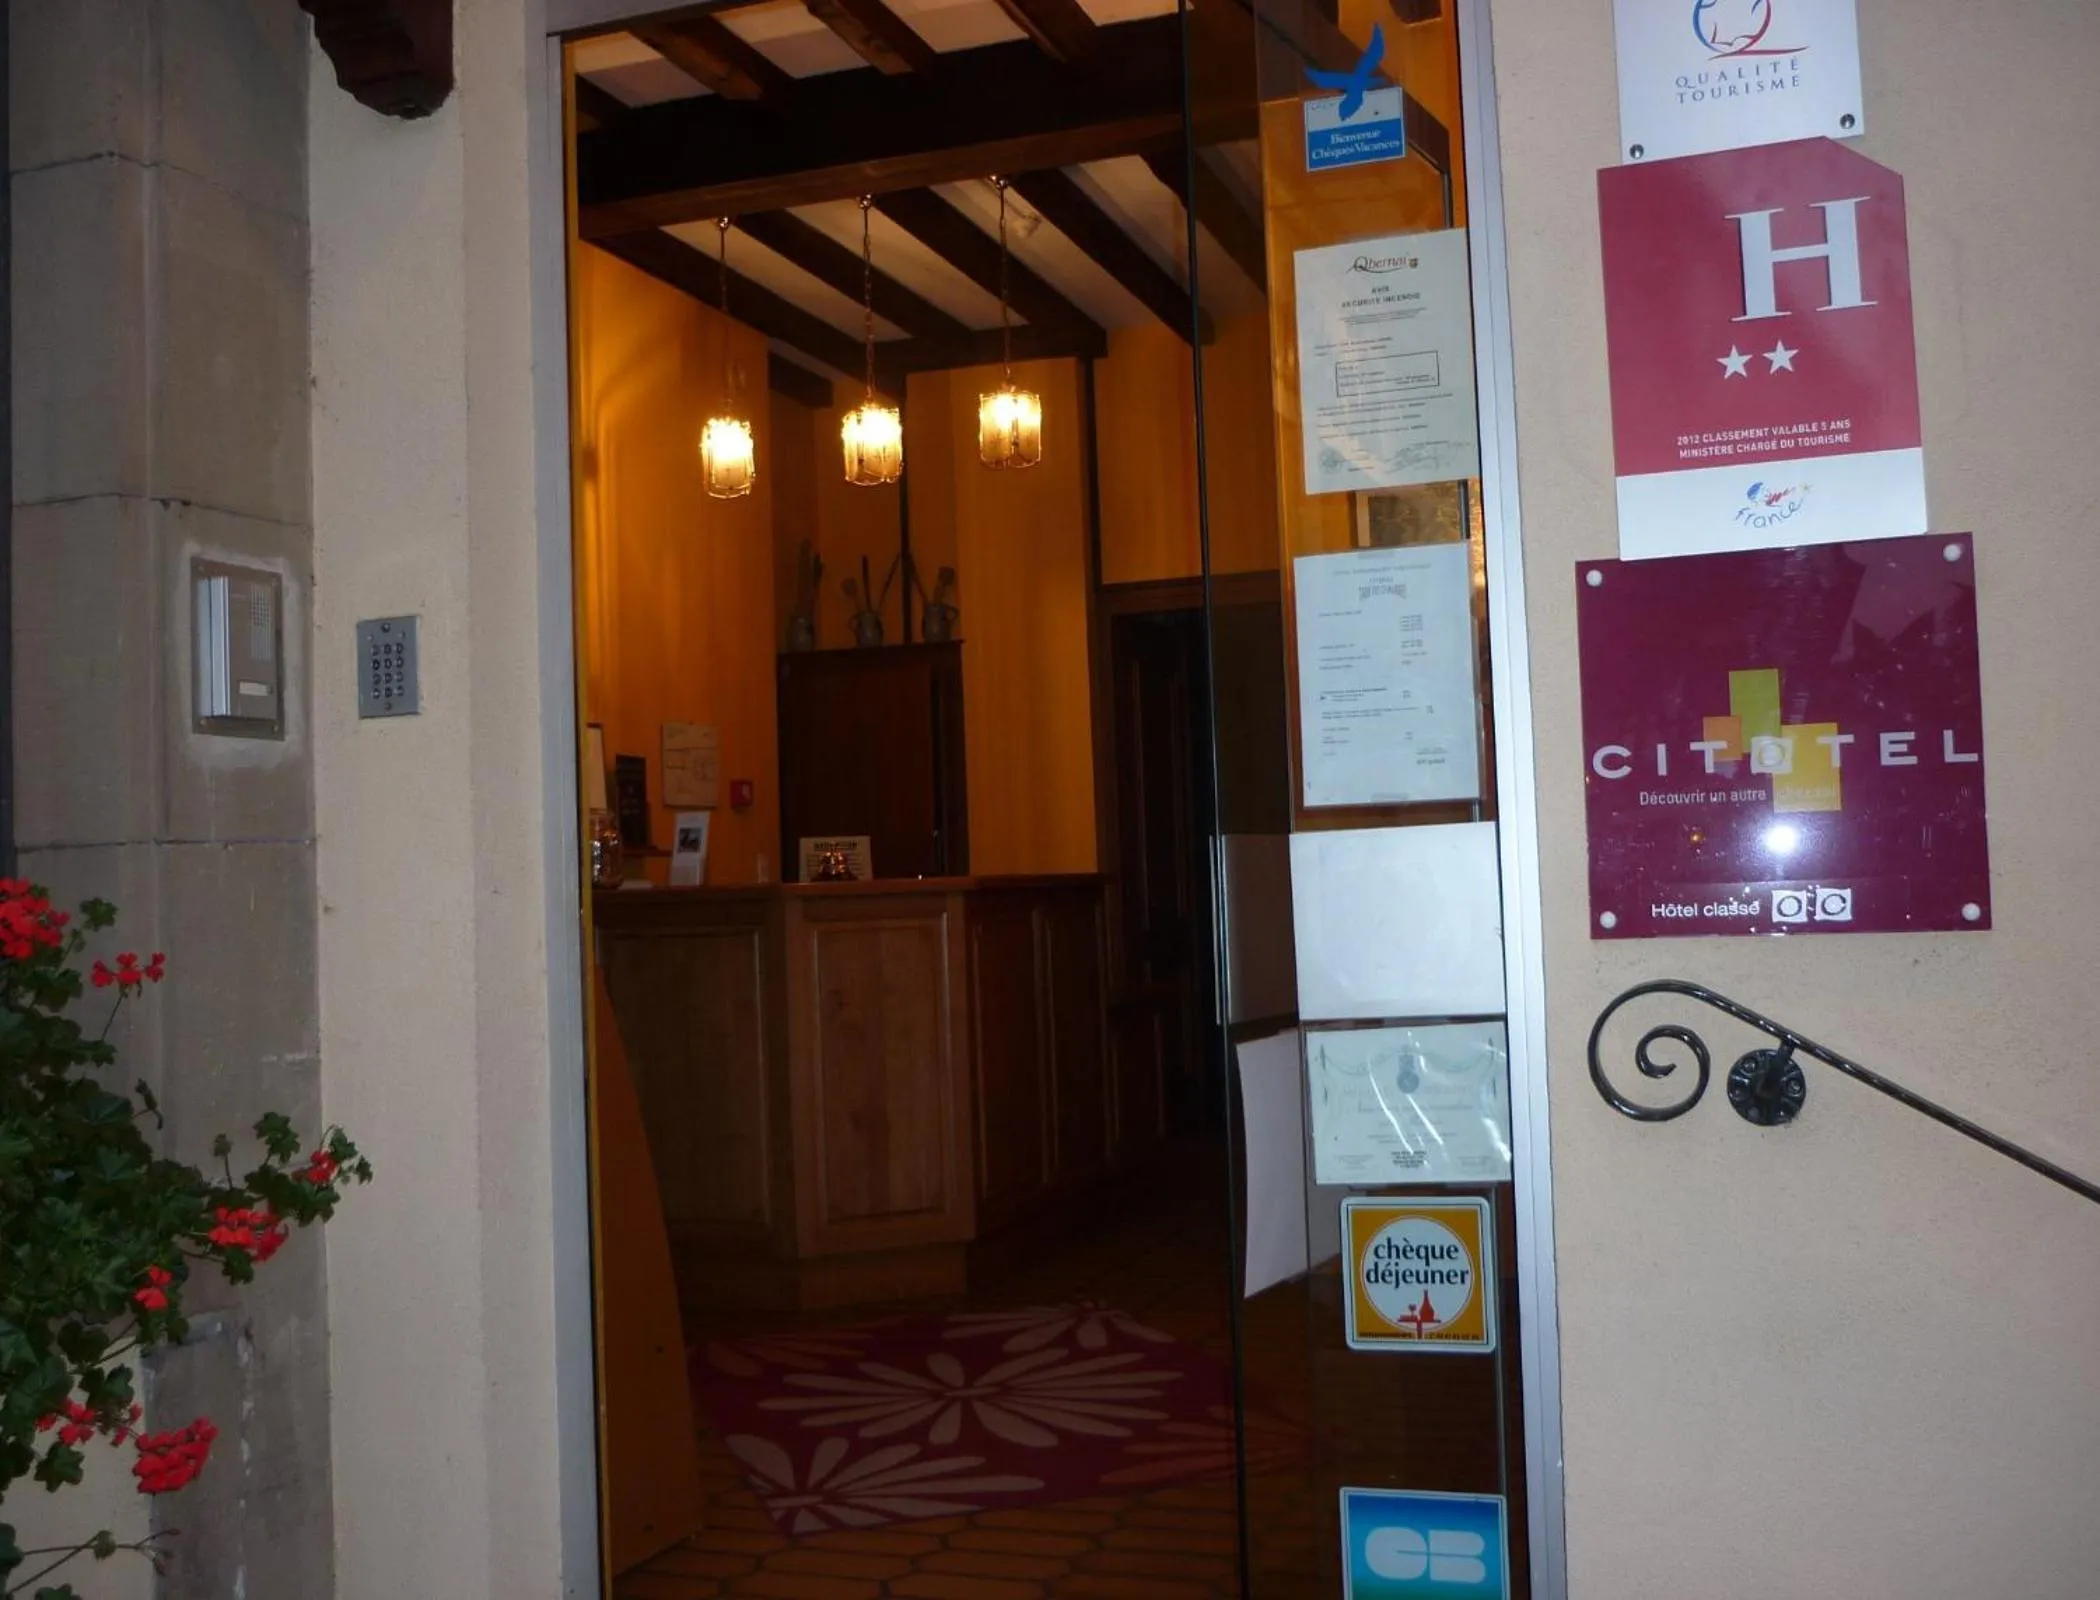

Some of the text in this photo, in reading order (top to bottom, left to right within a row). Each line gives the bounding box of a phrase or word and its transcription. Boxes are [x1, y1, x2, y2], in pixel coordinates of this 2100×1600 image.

[1676, 75, 1800, 104] TOURISME
[1724, 196, 1878, 321] H
[1677, 419, 1850, 446] 2012 CLASSEMENT VALABLE 5 ANS
[1780, 438, 1795, 449] DU
[1796, 433, 1849, 447] TOURISME
[1592, 729, 1979, 779] CITOTEL
[1640, 788, 1706, 806] Découvrir
[1710, 791, 1726, 803] un
[1651, 902, 1698, 917] Hôtel
[1373, 1236, 1459, 1267] chèque
[1365, 1262, 1469, 1290] déjeuner
